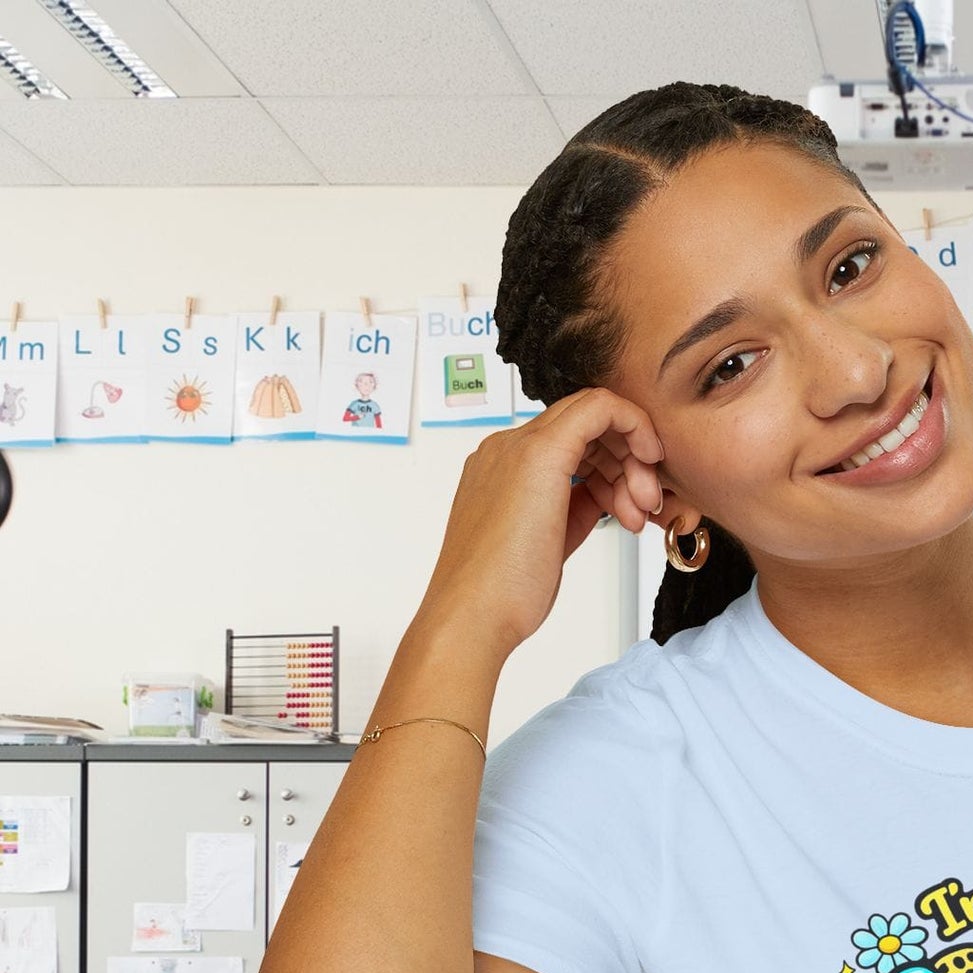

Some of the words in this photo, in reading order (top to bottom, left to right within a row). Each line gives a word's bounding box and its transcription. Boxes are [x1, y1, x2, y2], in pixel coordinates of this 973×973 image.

[939, 241, 957, 267] d
[19, 342, 44, 360] m
[75, 330, 92, 354] L
[162, 328, 181, 353] S
[203, 336, 218, 356] s
[245, 326, 265, 351] K
[286, 326, 302, 351] k
[348, 328, 390, 354] ich
[452, 379, 483, 391] Buch
